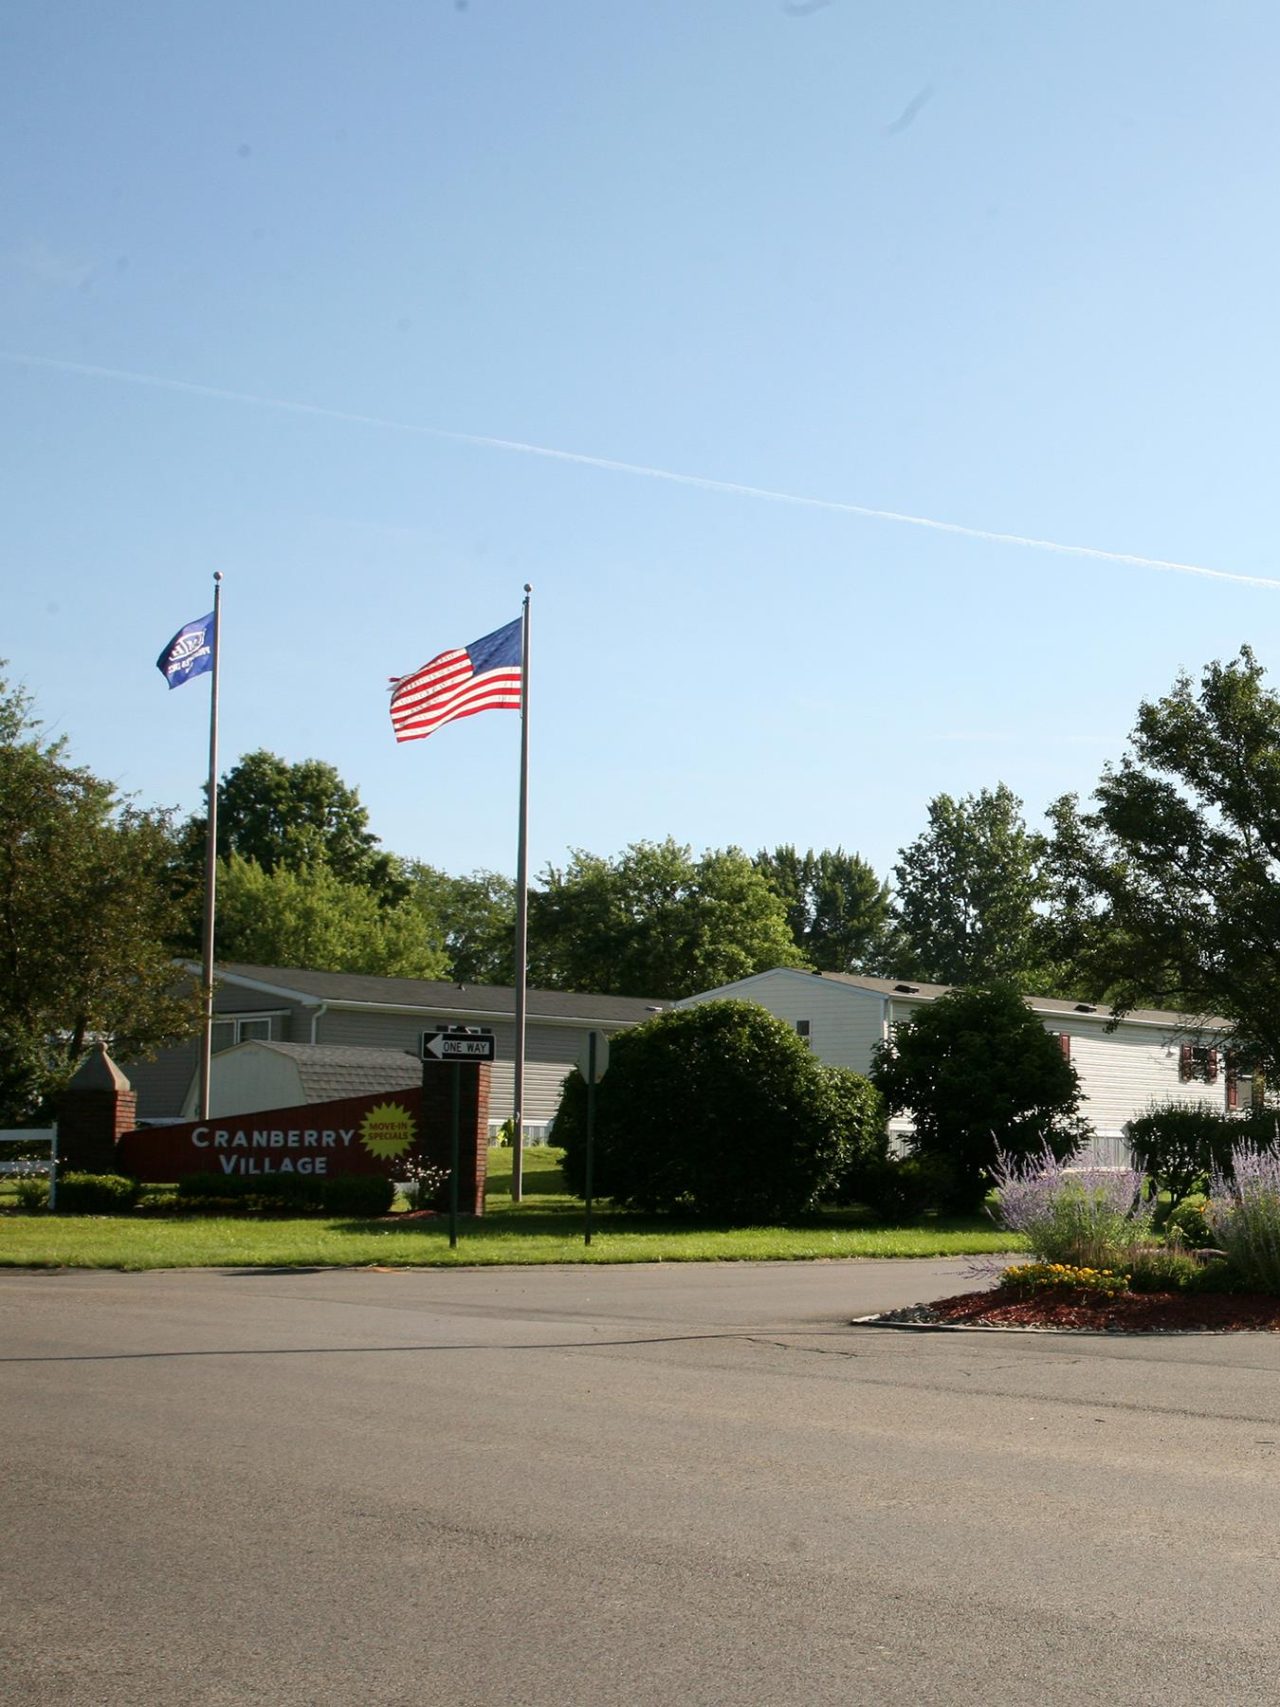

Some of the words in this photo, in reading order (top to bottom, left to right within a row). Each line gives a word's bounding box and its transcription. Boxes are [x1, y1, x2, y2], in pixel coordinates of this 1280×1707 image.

[443, 1041, 462, 1053] ONE
[466, 1042, 487, 1053] WAY
[369, 1122, 407, 1130] MOVE-IN
[191, 1127, 355, 1148] CRANBERRY
[368, 1132, 408, 1140] SPECIALS
[219, 1154, 327, 1175] VILLAGE
